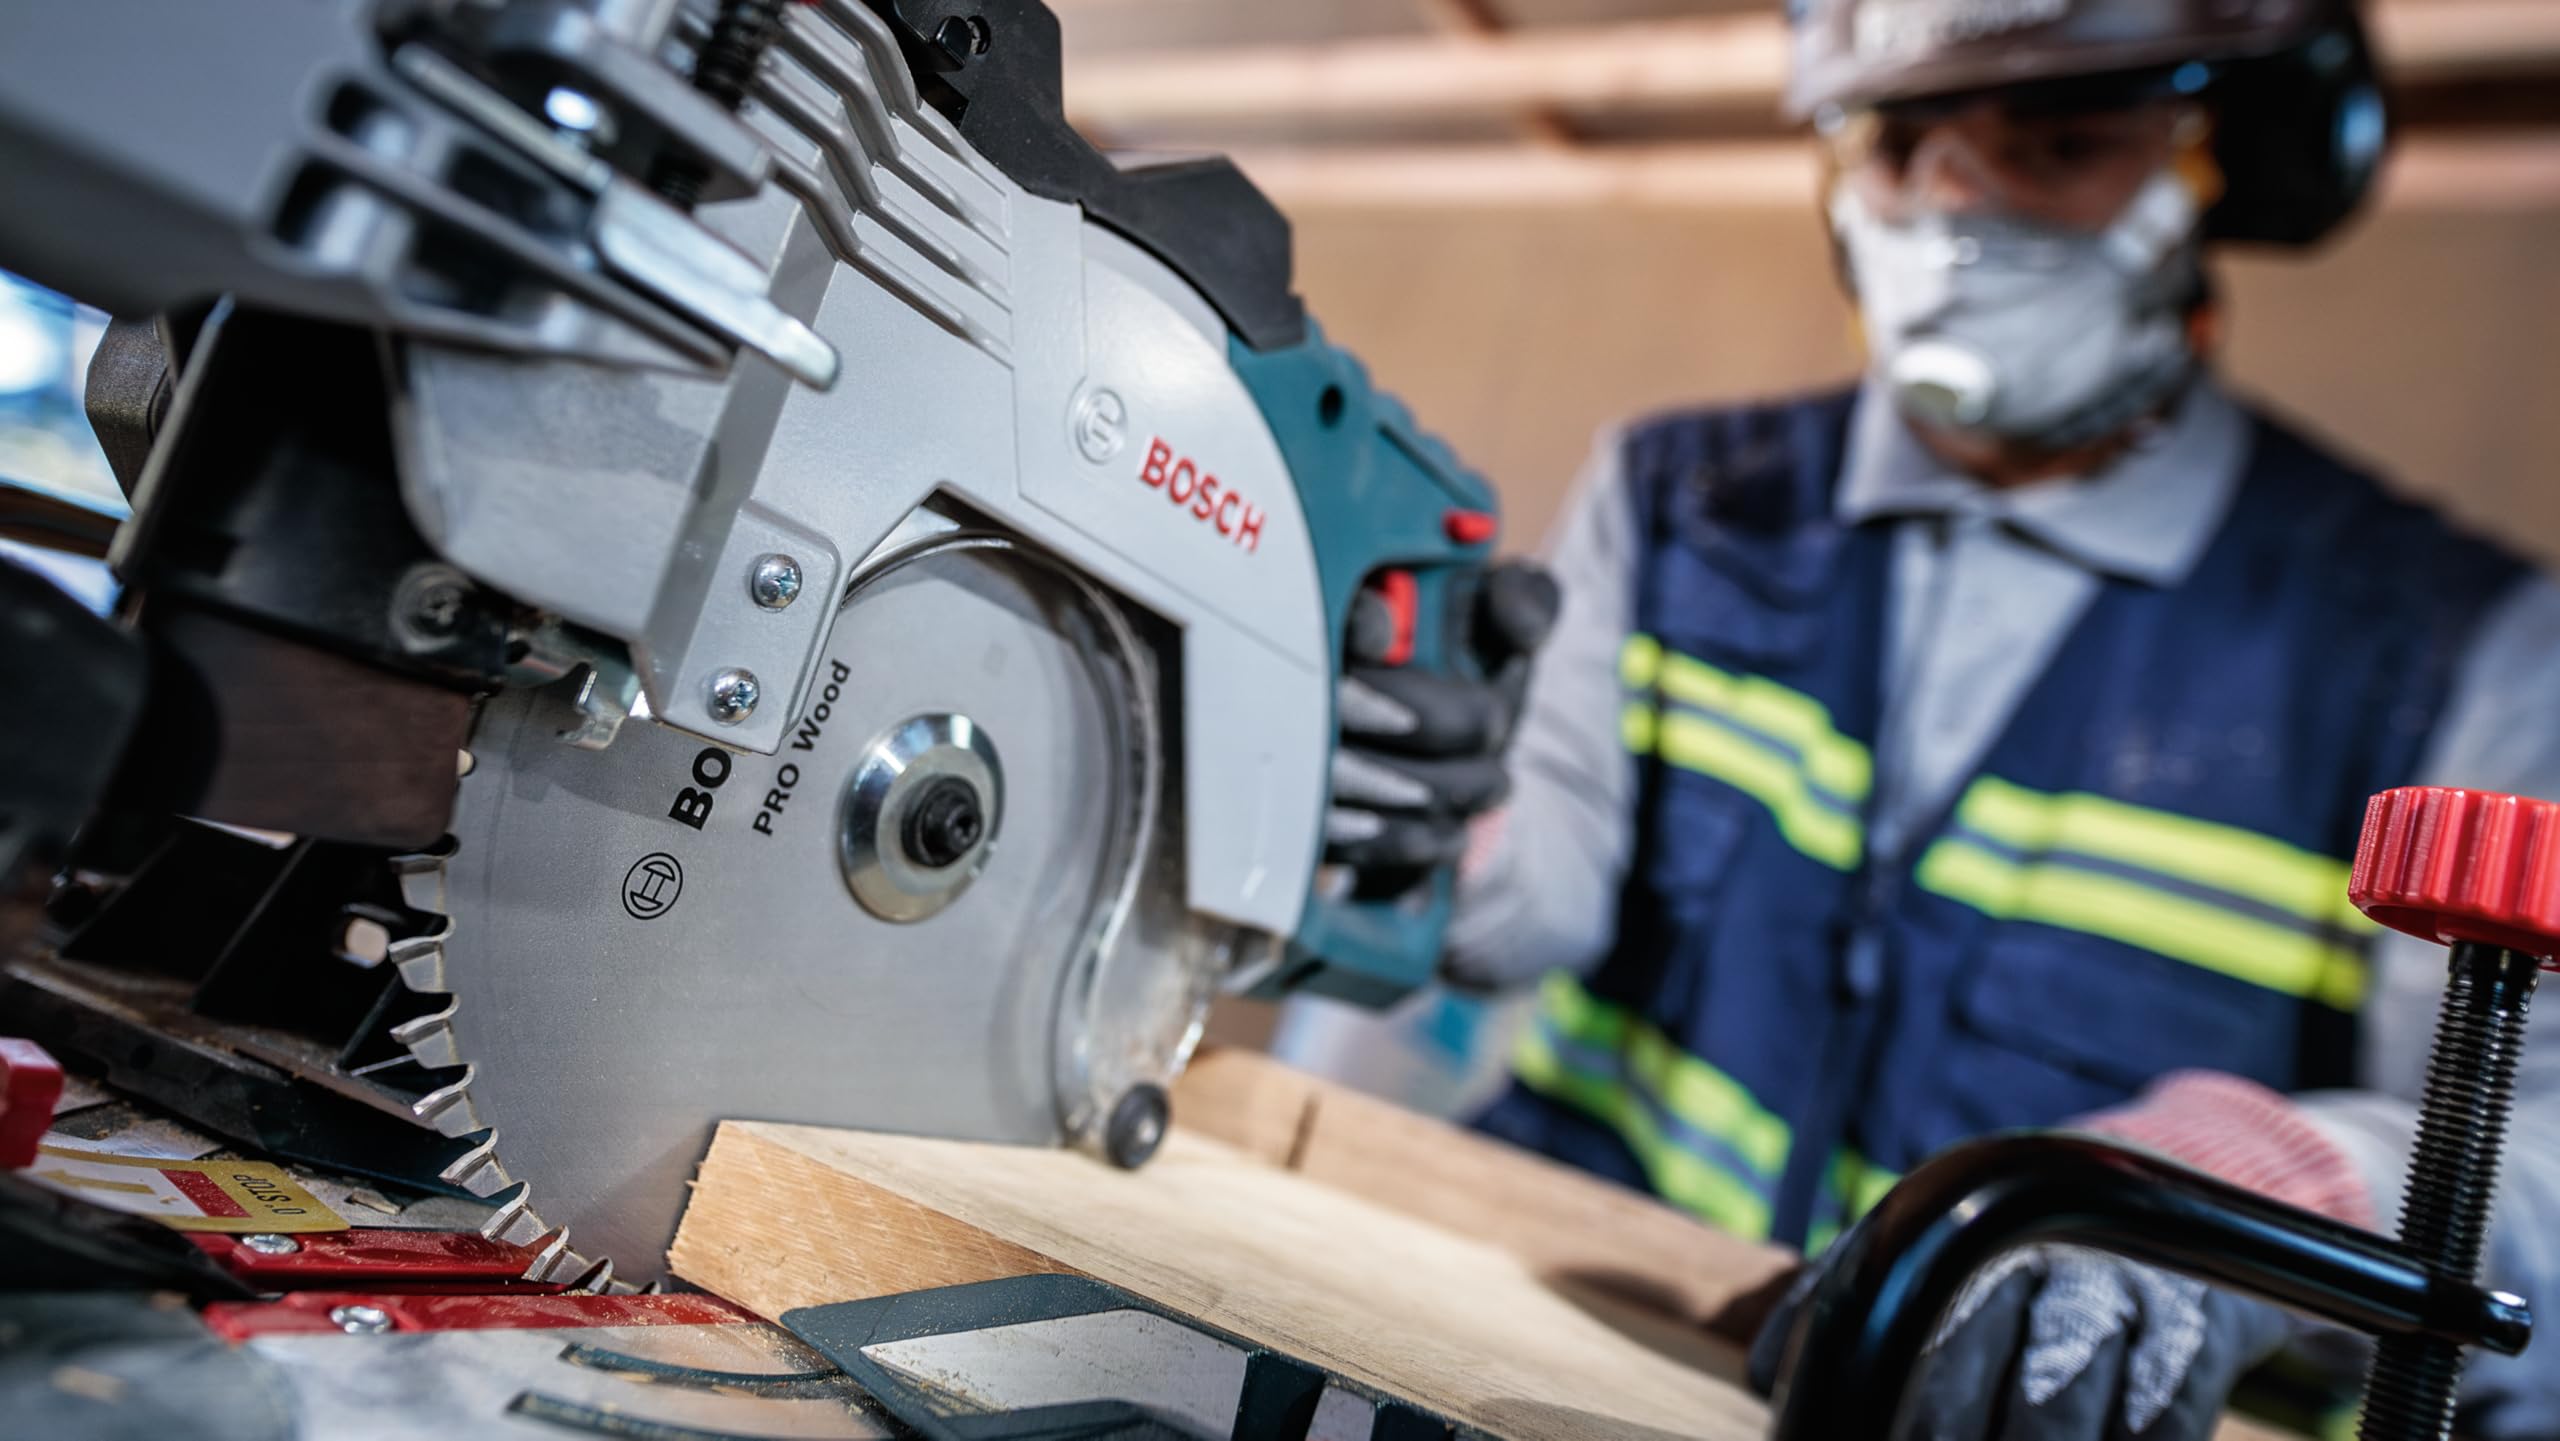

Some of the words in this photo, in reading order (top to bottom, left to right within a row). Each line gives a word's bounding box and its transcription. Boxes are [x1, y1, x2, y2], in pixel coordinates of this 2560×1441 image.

[1141, 435, 1267, 554] BOSCH
[752, 763, 800, 837] PRO
[792, 659, 851, 752] Wood
[232, 1174, 292, 1202] STOP
